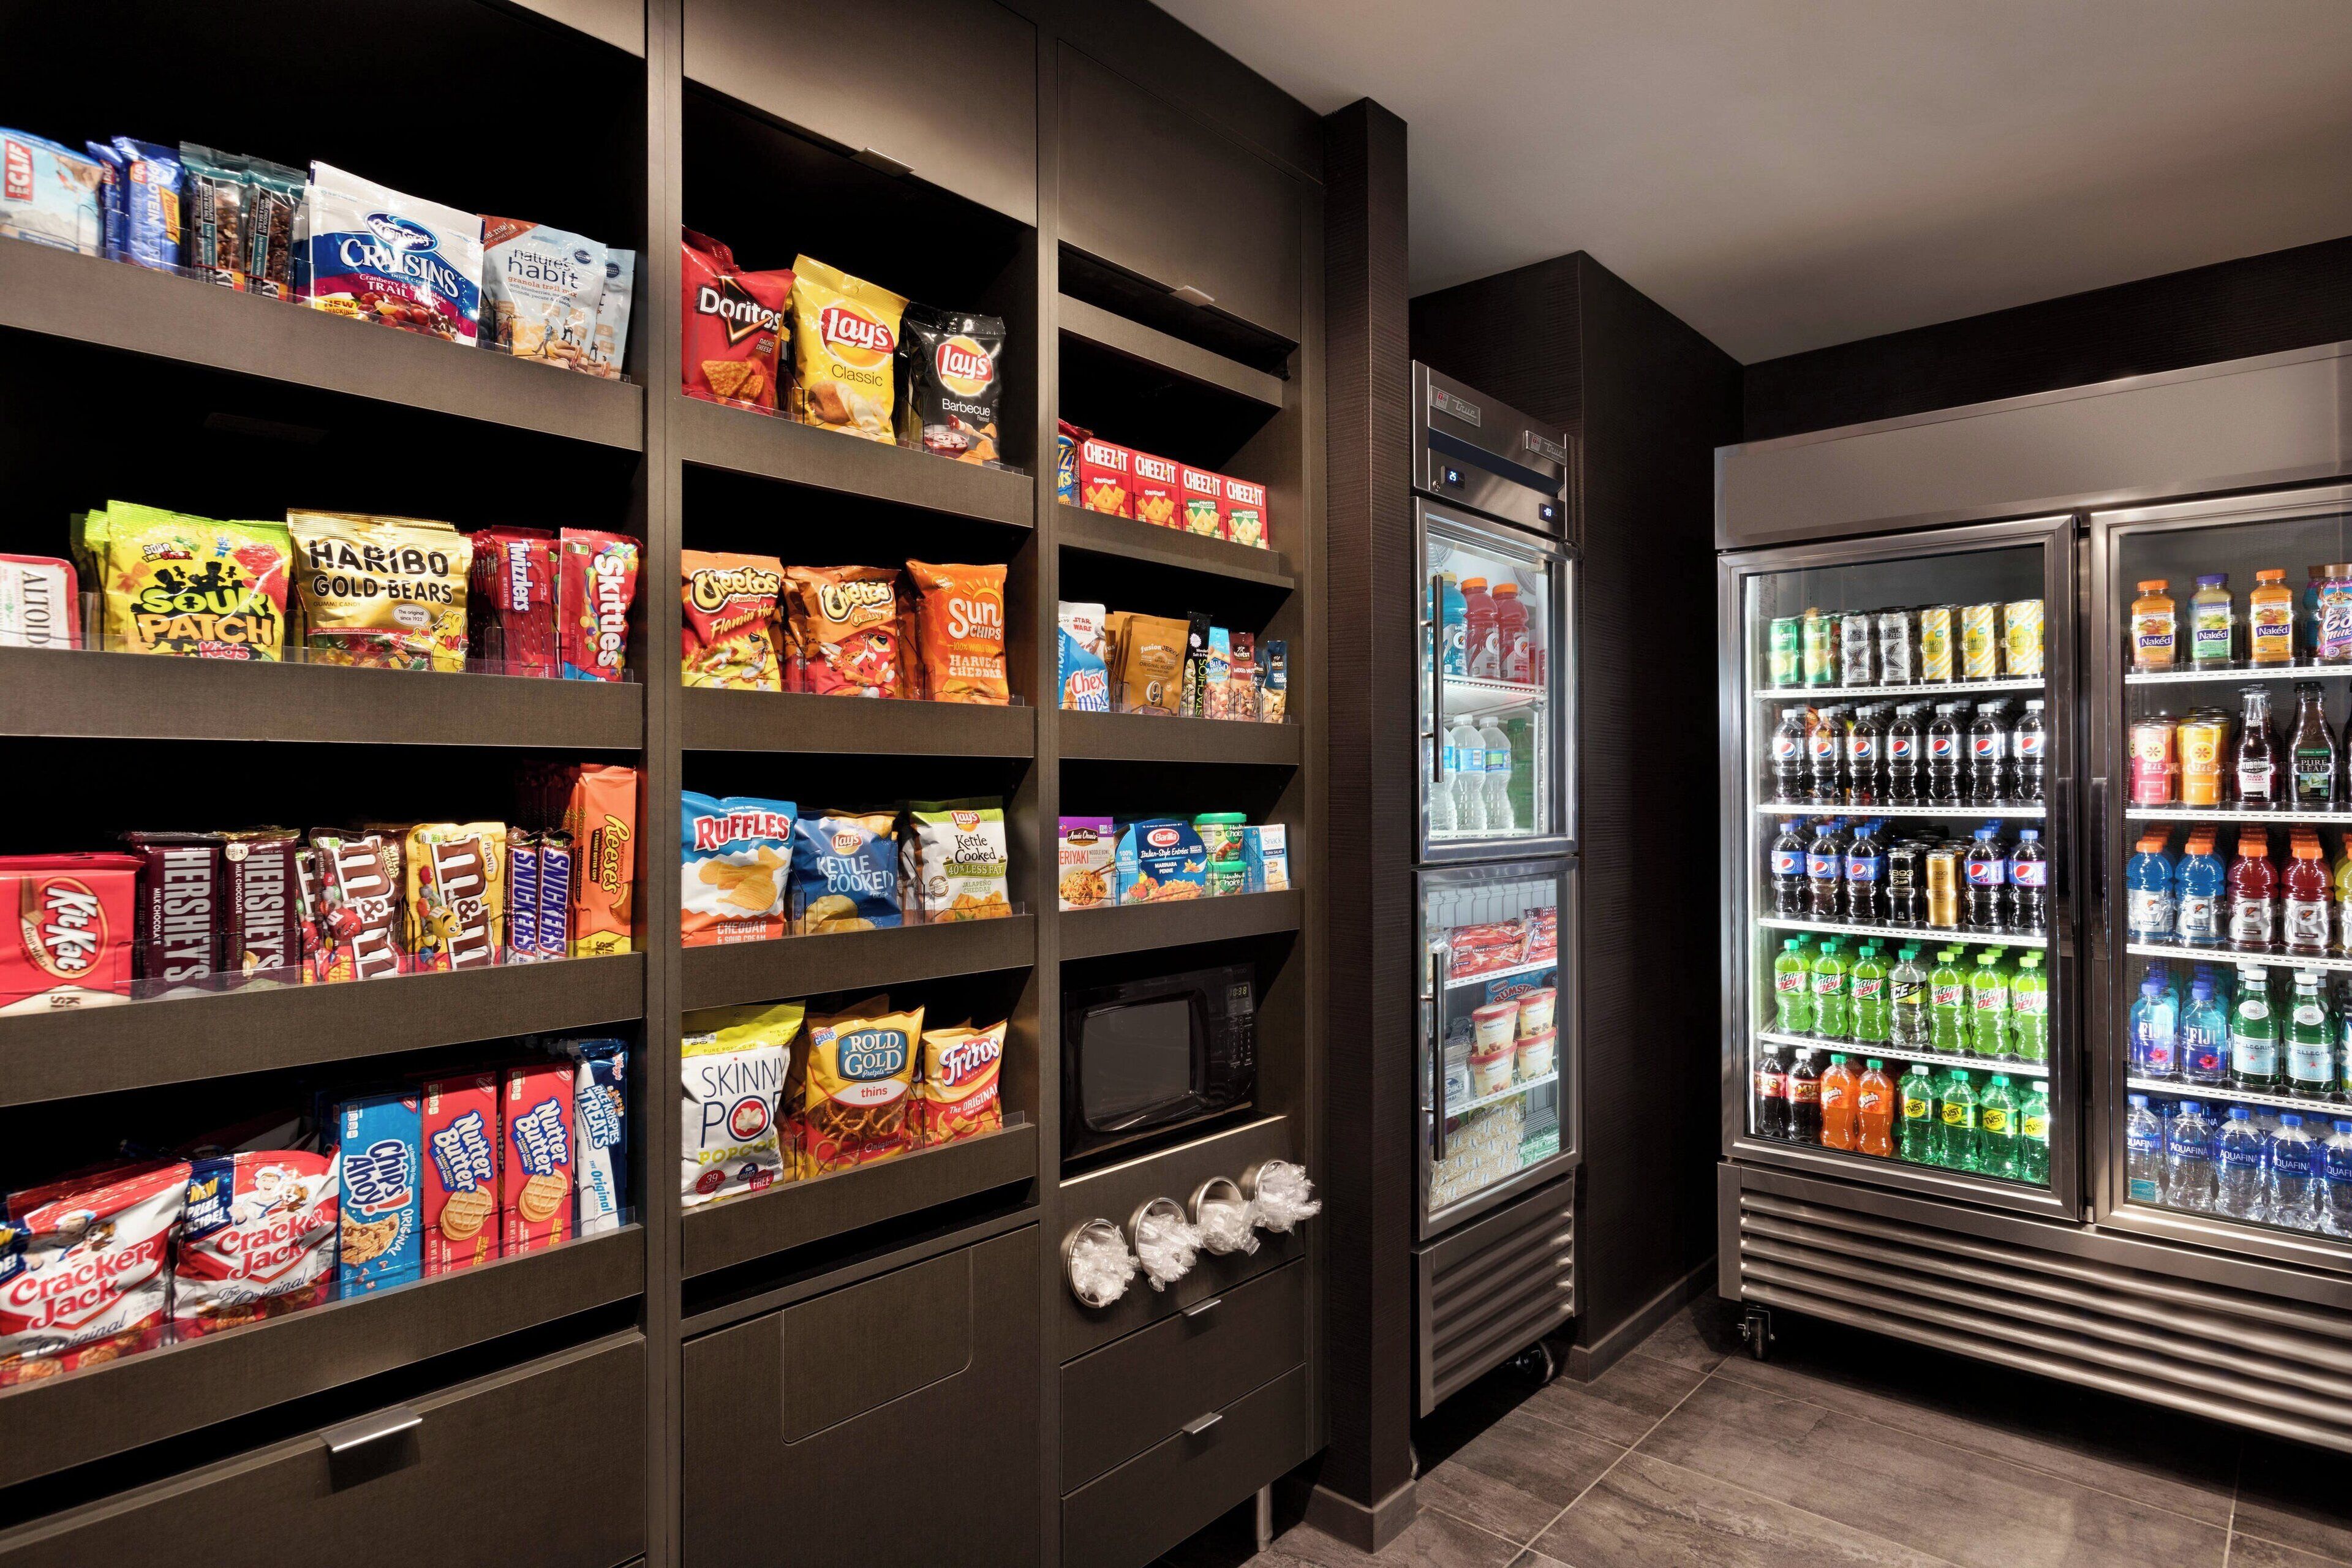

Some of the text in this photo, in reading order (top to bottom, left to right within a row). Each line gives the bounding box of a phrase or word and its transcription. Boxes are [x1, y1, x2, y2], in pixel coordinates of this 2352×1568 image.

[8, 143, 31, 186] CLIF
[8, 185, 30, 195] BAR
[148, 162, 160, 225] PROTEIN
[340, 238, 458, 298] CRAISINS
[508, 257, 578, 289] habit
[360, 274, 399, 288] Cranberry
[368, 281, 409, 298] TRAIL
[508, 276, 578, 298] granola trail mix
[699, 287, 782, 332] Doritos
[826, 309, 890, 349] Lay's
[756, 344, 773, 354] CHEESE
[759, 338, 775, 347] NACHO
[941, 345, 991, 380] Lay's
[832, 364, 883, 387] Classic
[942, 398, 991, 417] Barbecue
[976, 414, 990, 423] Flavored
[143, 543, 173, 555] SOUR
[309, 540, 449, 578] HARIBO
[508, 541, 533, 612] Twizzlers
[141, 586, 268, 616] SOUR
[313, 576, 454, 604] GOLD-BEARS
[694, 567, 780, 612] Cheetos
[22, 570, 50, 649] ALTOID
[593, 554, 625, 666] Skittles
[758, 605, 774, 619] Hot
[850, 611, 882, 626] Crunchy
[948, 598, 1003, 639] Sun
[137, 613, 274, 645] PATCH
[969, 625, 1001, 641] CHIPS
[198, 641, 250, 660] Kids
[953, 642, 985, 652] 100% WHOLE
[949, 666, 1003, 679] CHEDDAR
[950, 655, 1001, 668] HARVEST
[1072, 670, 1105, 694] Chex
[696, 813, 789, 849] RUFFLES
[954, 834, 988, 850] Kettle
[1155, 833, 1177, 842] Barilla
[1264, 837, 1283, 845] Snack
[382, 846, 397, 879] CHOCOLATE
[388, 845, 401, 876] MILK
[484, 842, 496, 874] PEANUT
[601, 814, 631, 895] Reese's
[816, 855, 872, 876] KETTLE
[955, 847, 997, 864] Cooked
[1060, 850, 1089, 865] ERIYAKI
[827, 870, 894, 893] COOKED
[949, 865, 1003, 875] 40% LESS FAT
[962, 879, 992, 888] JALAPEÑO
[244, 854, 285, 970] HERSHEY'S
[513, 851, 537, 953] SNICKERS
[539, 848, 568, 953] SNICKERS
[153, 888, 162, 945] MILK CHOCOLATE
[164, 851, 211, 982] HERSHEY'S
[717, 921, 766, 935] CHEDDAR
[24, 927, 48, 968] Crisp Wafers
[1890, 983, 1910, 1000] ICE
[812, 1027, 833, 1038] HUNGER
[813, 1032, 837, 1047] GRAB
[849, 1032, 899, 1052] ROLD
[2189, 1027, 2216, 1046] FIJI
[845, 1049, 902, 1076] GOLD
[939, 1037, 1000, 1086] Fritos
[702, 1056, 788, 1098] SKINNY
[862, 1069, 884, 1078] Pretzels
[861, 1086, 888, 1098] thins
[576, 1087, 609, 1150] TREATS
[593, 1085, 620, 1145] RICE KRISPIES
[949, 1106, 961, 1114] The
[516, 1099, 568, 1175] Nutter Butter
[520, 1137, 530, 1154] PEANUT
[864, 1133, 902, 1153] Original
[2127, 1139, 2157, 1148] QUAFINA
[434, 1112, 494, 1191] Nutter Butter
[2170, 1143, 2208, 1156] AQUAFINA
[2220, 1150, 2258, 1163] AQUAFINA
[440, 1153, 450, 1171] PEANUT
[2271, 1157, 2311, 1171] AQUAFINA
[2323, 1164, 2352, 1177] AQUAFI
[706, 1172, 718, 1185] 39
[753, 1176, 771, 1189] FREE
[591, 1170, 613, 1212] Original
[187, 1196, 219, 1219] PRIZE
[216, 1208, 323, 1255] Cracker
[228, 1238, 305, 1281] Jack
[10, 1241, 154, 1306] Cracker
[217, 1268, 307, 1305] The Original
[30, 1279, 119, 1329] Jack
